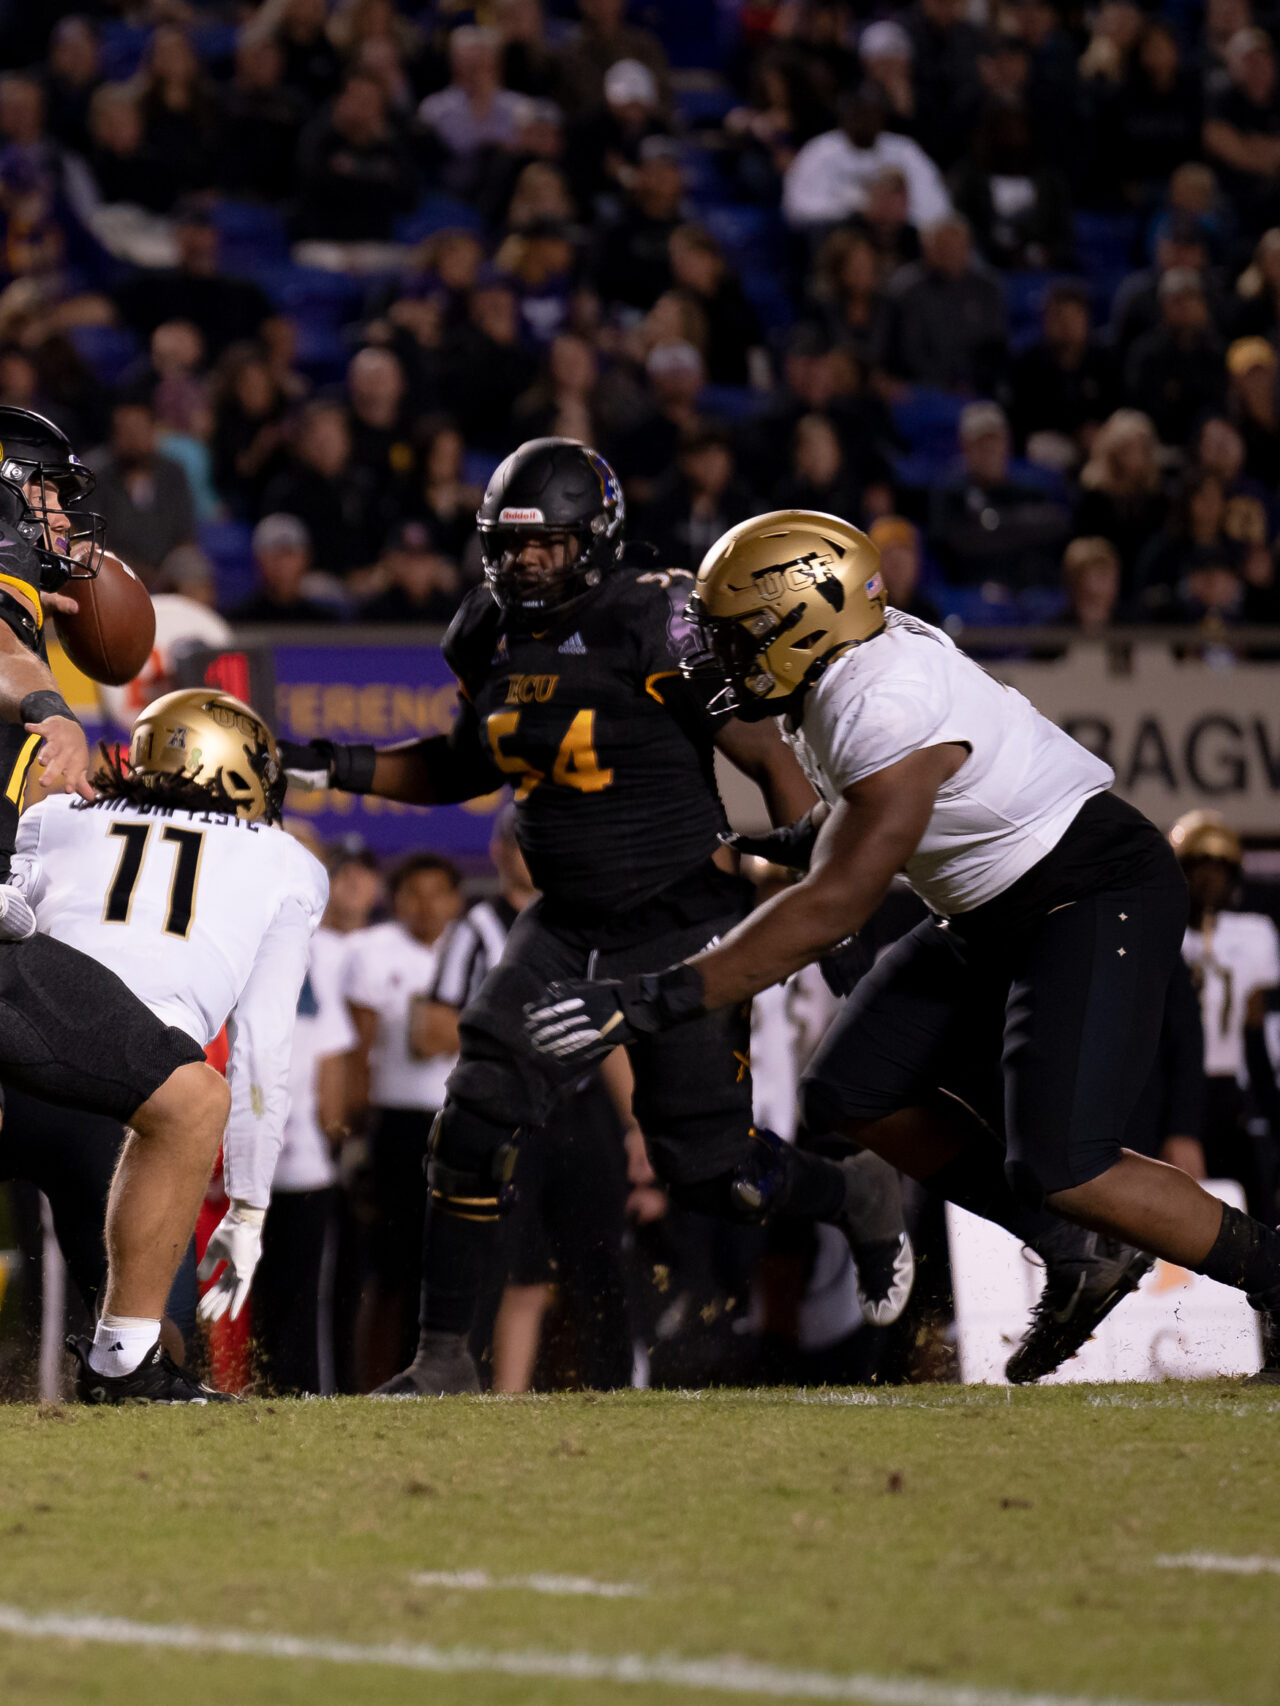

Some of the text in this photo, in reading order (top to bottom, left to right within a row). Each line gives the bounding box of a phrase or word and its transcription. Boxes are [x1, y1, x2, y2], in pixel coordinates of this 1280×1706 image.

[752, 553, 833, 601] UCF
[505, 673, 561, 704] ECU
[486, 708, 613, 799] 54
[101, 820, 207, 942] 11
